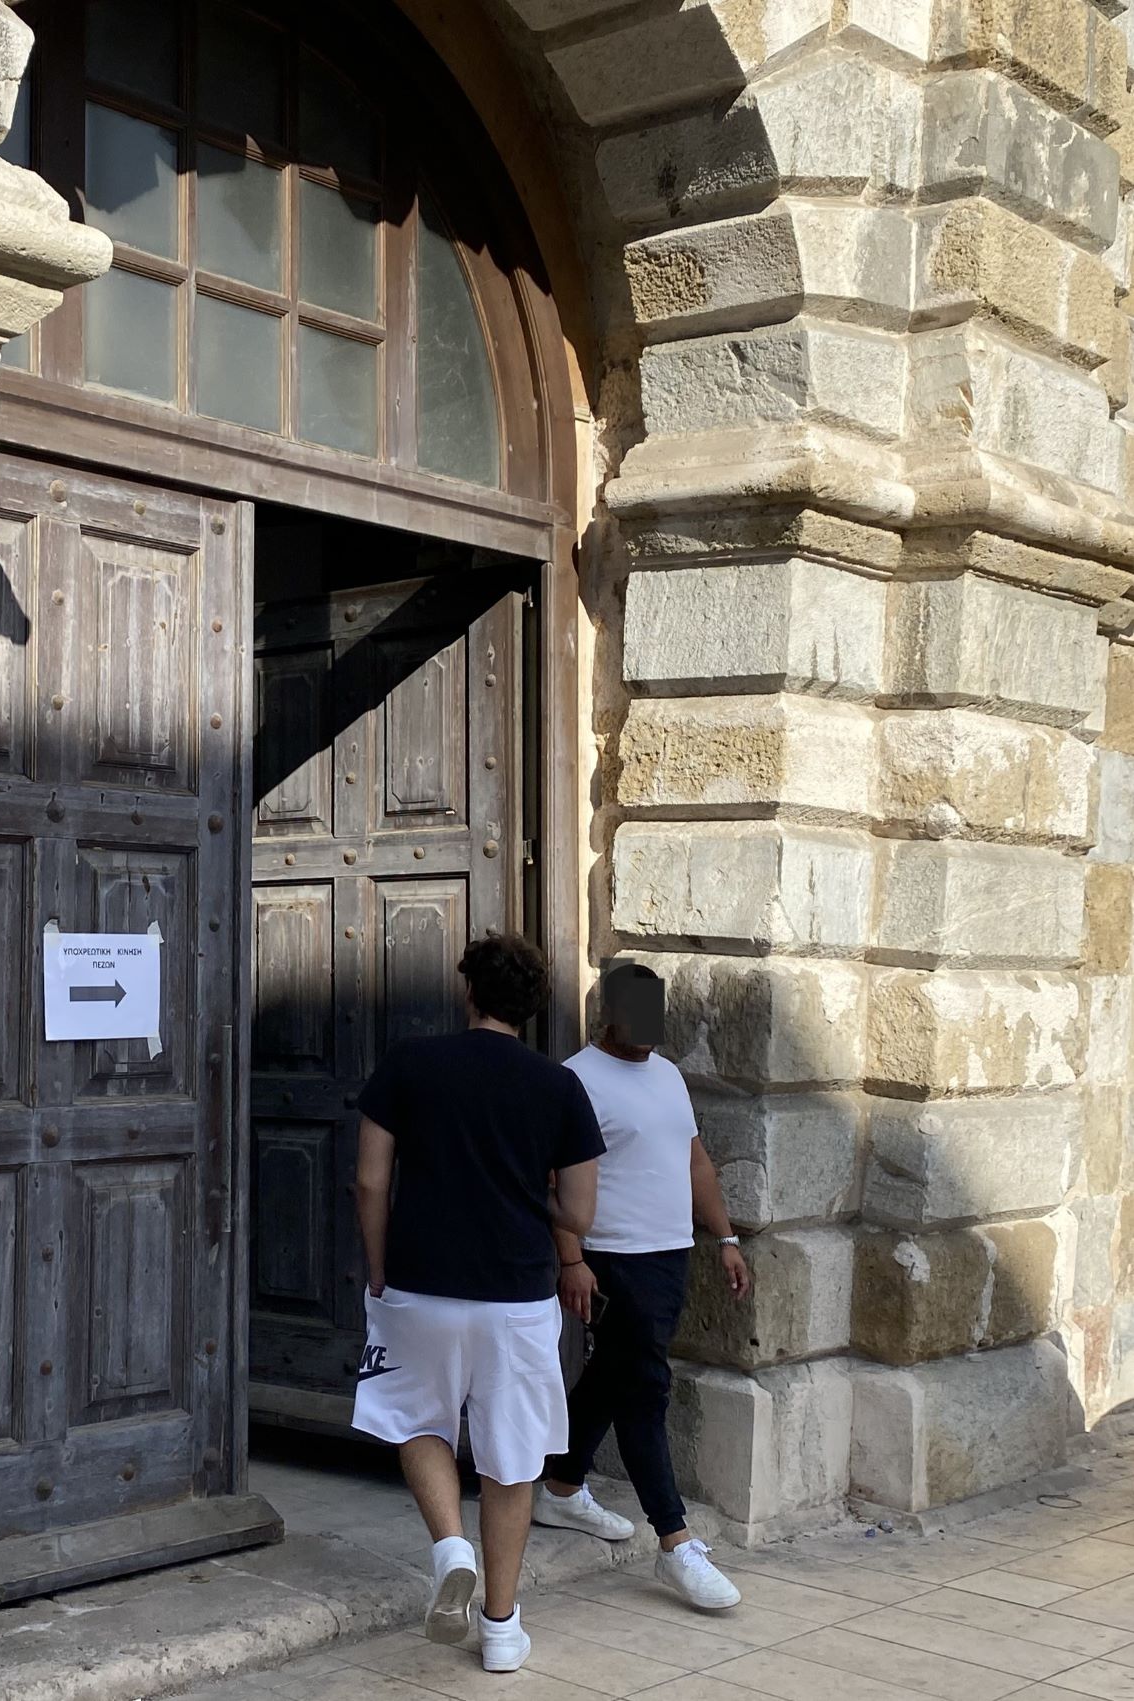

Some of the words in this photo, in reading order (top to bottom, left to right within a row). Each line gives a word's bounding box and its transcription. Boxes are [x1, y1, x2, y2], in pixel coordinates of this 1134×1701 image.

[63, 947, 111, 956] ΥΠΟΧΡΕΩΤΙΚΗ
[117, 947, 143, 956] ΚΙΝΗΣΗ
[92, 960, 116, 969] ΠΕΖΩΝ
